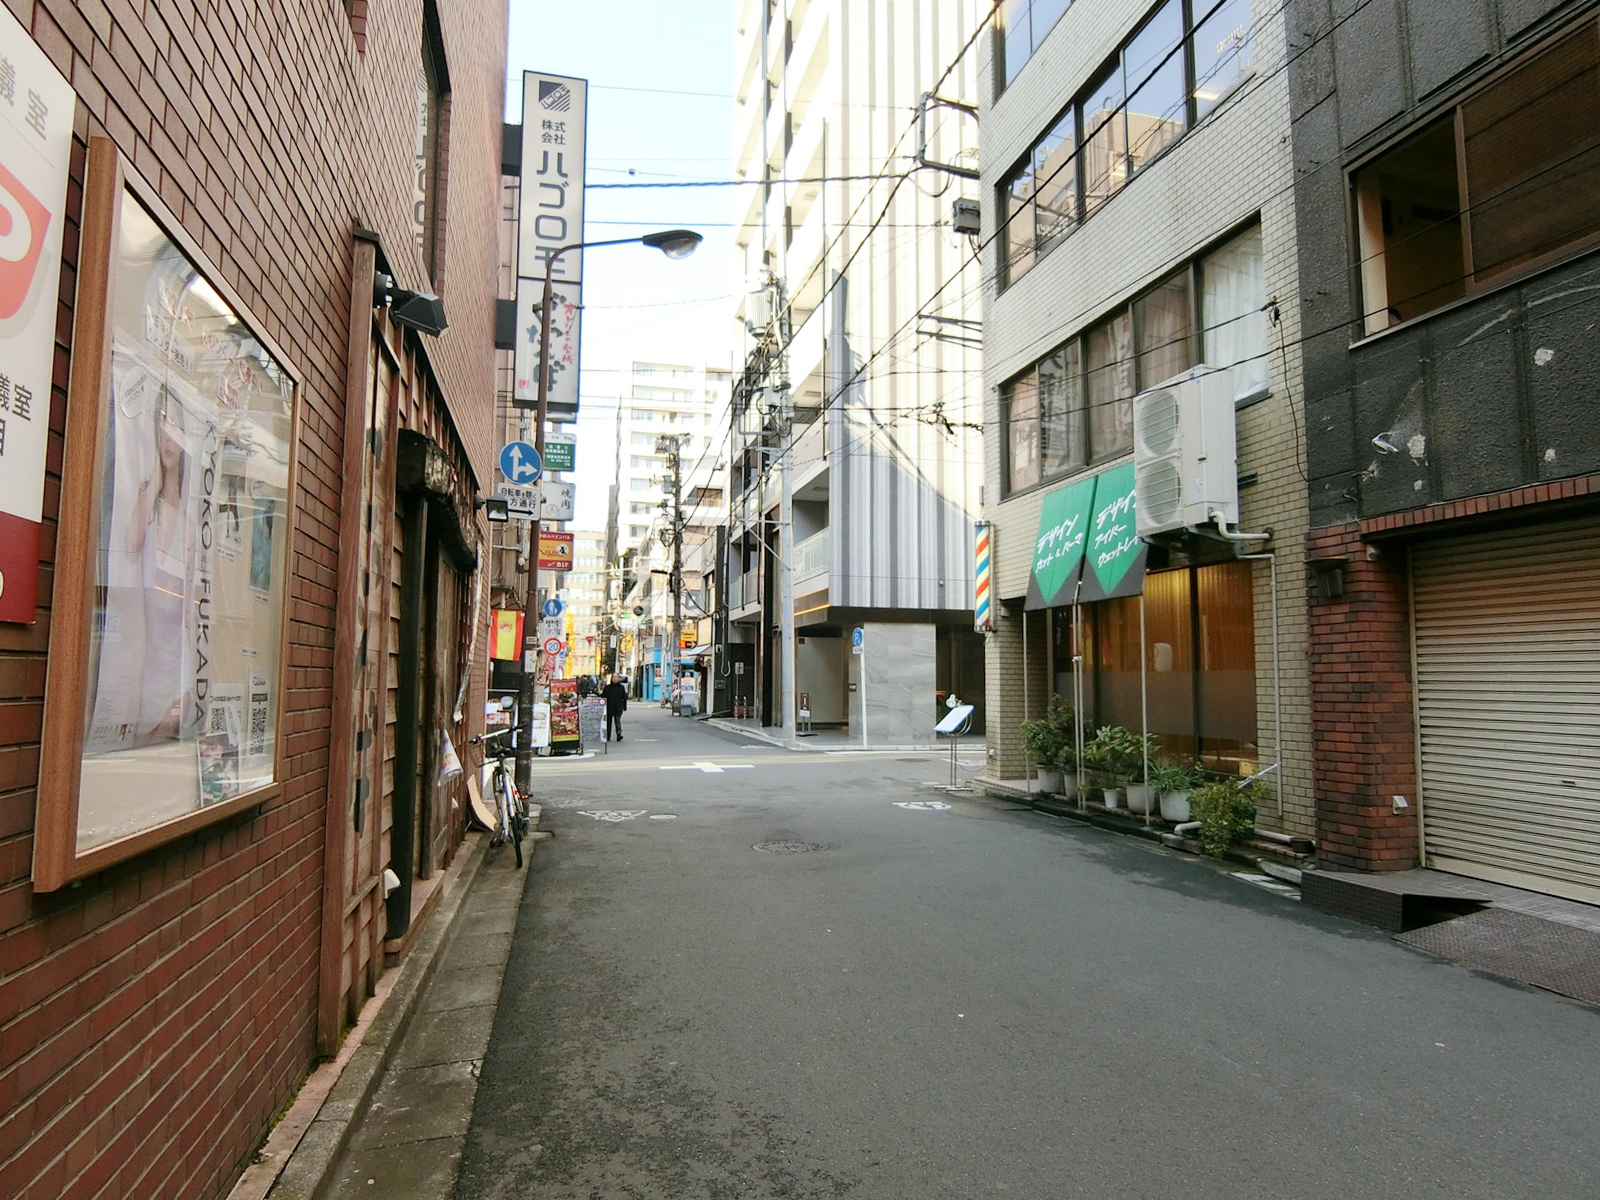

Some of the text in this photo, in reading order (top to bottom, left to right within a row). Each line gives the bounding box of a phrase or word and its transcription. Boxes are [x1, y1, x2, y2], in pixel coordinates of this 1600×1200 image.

[541, 118, 566, 133] 株式
[541, 131, 566, 146] 会社
[534, 150, 570, 275] ハゴロモ
[509, 498, 536, 509] 方通行
[1037, 513, 1079, 555] デザイン
[193, 578, 212, 726] FUKADA
[548, 642, 559, 651] 20
